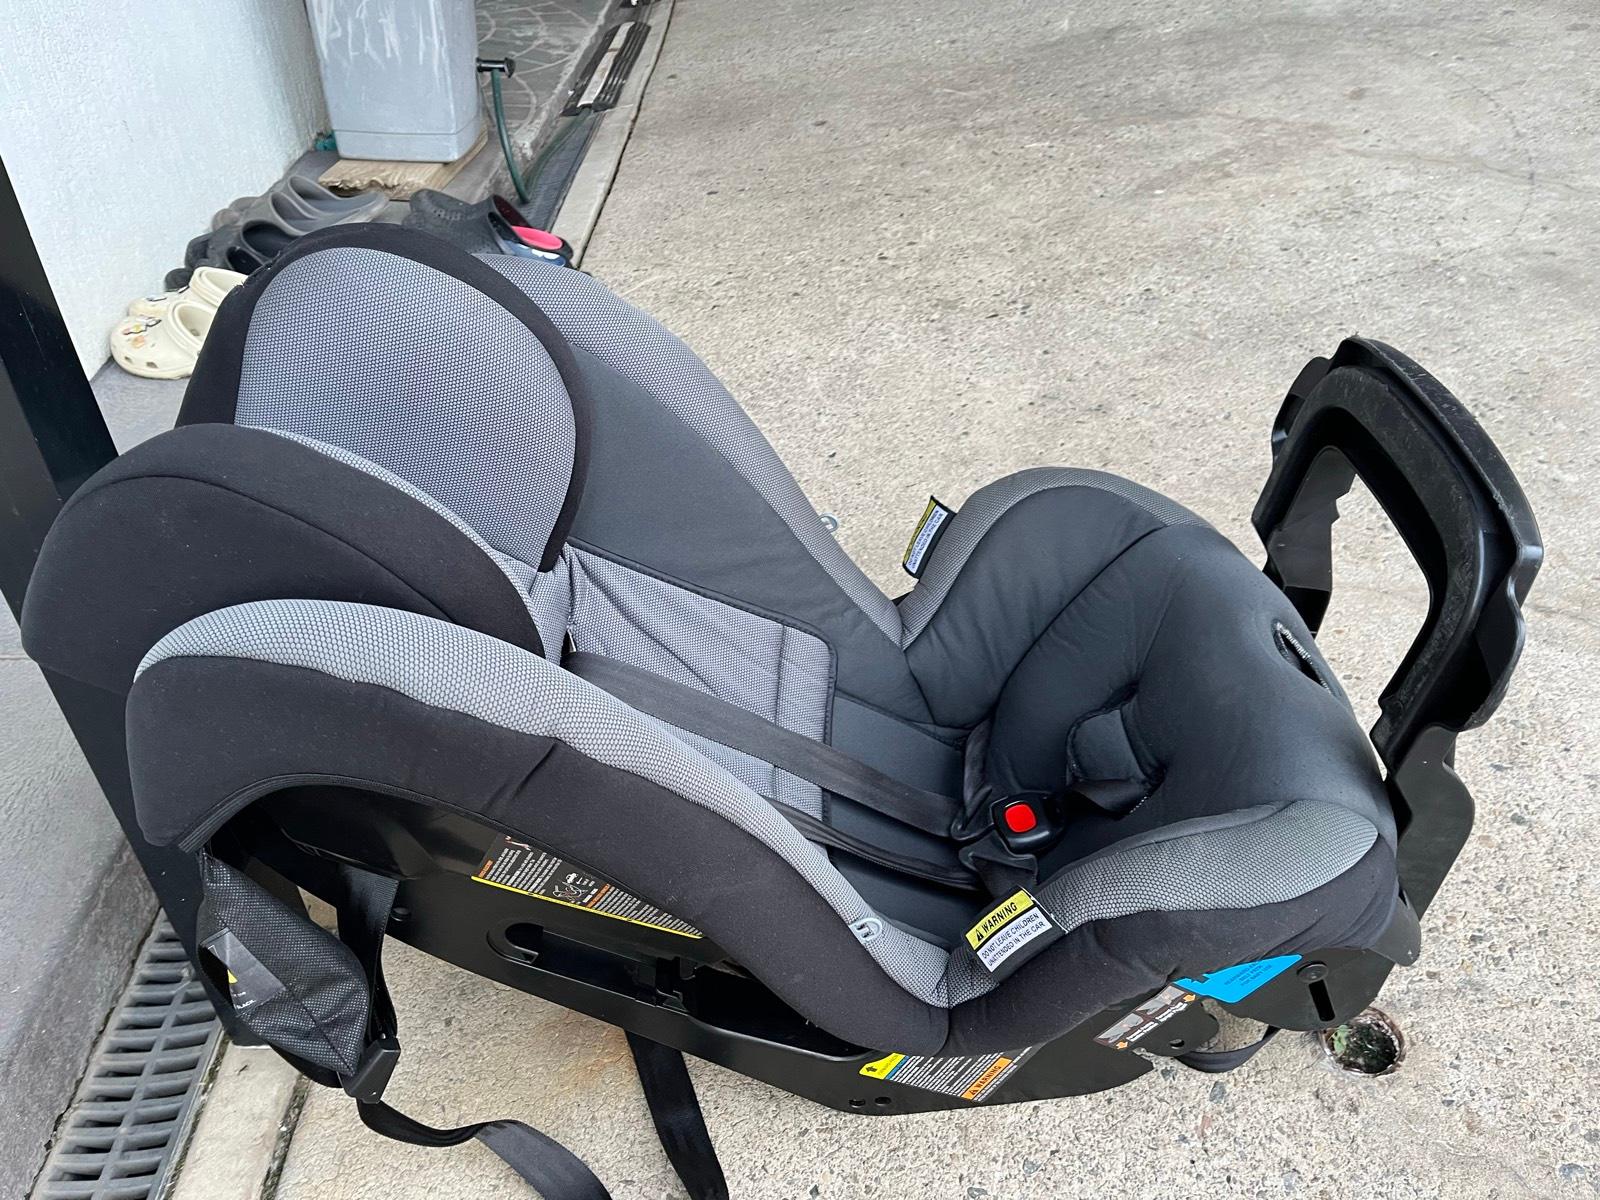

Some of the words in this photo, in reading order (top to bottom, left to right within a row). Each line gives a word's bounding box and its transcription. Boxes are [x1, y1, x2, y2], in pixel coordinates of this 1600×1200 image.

[981, 902, 1018, 933] WARNING
[982, 951, 989, 959] DO
[988, 941, 997, 955] NOT
[997, 932, 1012, 946] LEAVE
[1010, 913, 1039, 937] CHILDREN
[987, 941, 1015, 967] UNATTENDED
[1019, 930, 1032, 941] THE
[1030, 921, 1046, 933] CAR
[973, 1065, 1002, 1089] WARNING
